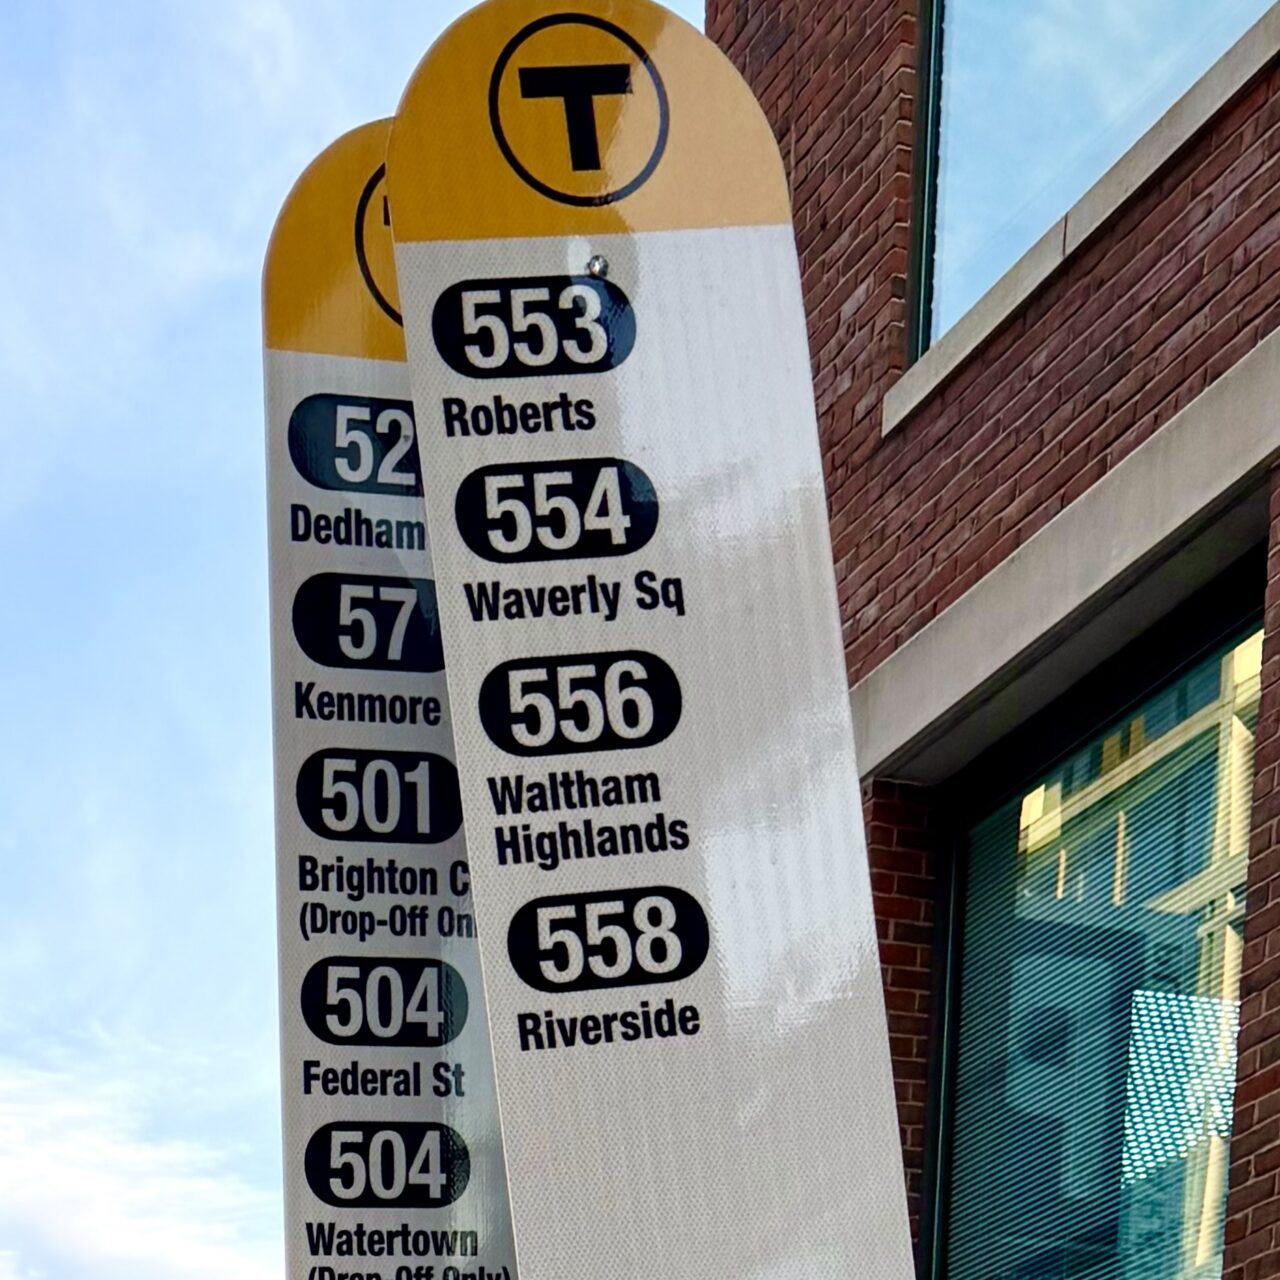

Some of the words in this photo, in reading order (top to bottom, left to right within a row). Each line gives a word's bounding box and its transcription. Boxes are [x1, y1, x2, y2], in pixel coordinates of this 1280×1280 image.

[518, 63, 634, 173] T
[461, 283, 609, 370] 553
[443, 393, 597, 438] Roberts
[334, 404, 417, 486] 52
[291, 503, 426, 551] Dedham
[484, 466, 632, 554] 554
[338, 584, 417, 662] 57
[463, 574, 621, 622] Waverly
[635, 570, 686, 617] Sq
[294, 681, 442, 727] Kenmore
[508, 659, 655, 748] 556
[321, 758, 432, 835] 501
[487, 770, 661, 816] Waltham
[494, 814, 690, 870] Highlands
[298, 855, 438, 901] Brighton
[299, 902, 429, 942] (Drop-Off
[536, 896, 683, 985] 558
[325, 965, 445, 1038] 504
[517, 999, 701, 1051] Riverside
[303, 1060, 421, 1097] Federal
[432, 1061, 466, 1098] St
[328, 1130, 447, 1200] 504
[306, 1222, 478, 1257] Watertown
